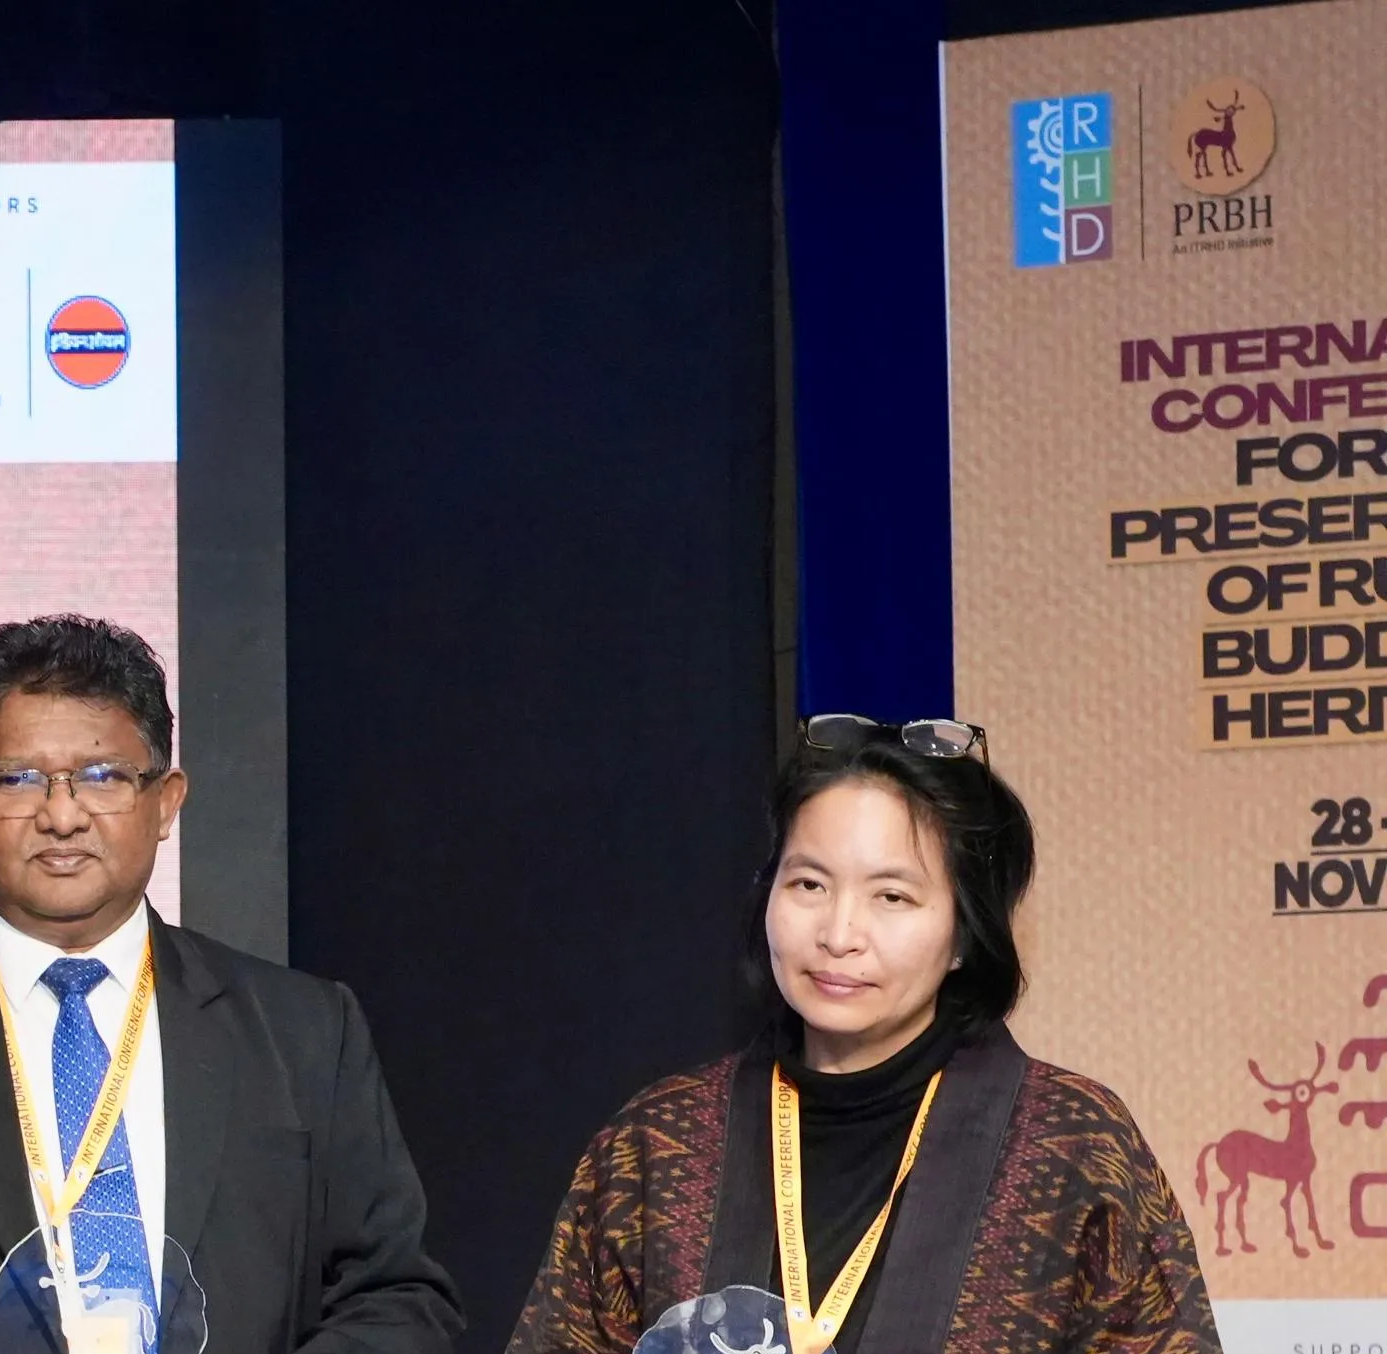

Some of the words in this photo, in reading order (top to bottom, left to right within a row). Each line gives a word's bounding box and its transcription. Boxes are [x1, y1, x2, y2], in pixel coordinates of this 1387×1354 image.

[1173, 195, 1273, 236] PRBH
[1151, 373, 1387, 433] CONFE
[1236, 429, 1387, 486] FOR
[1206, 561, 1311, 615] OF
[1319, 557, 1387, 607] R
[83, 1073, 124, 1165] INTERNATIONAL
[116, 1001, 143, 1074] CONFERENCE
[135, 981, 148, 1005] FOR
[778, 1110, 794, 1198] CONFERENCE
[781, 1201, 803, 1302] INTERNATIONAL
